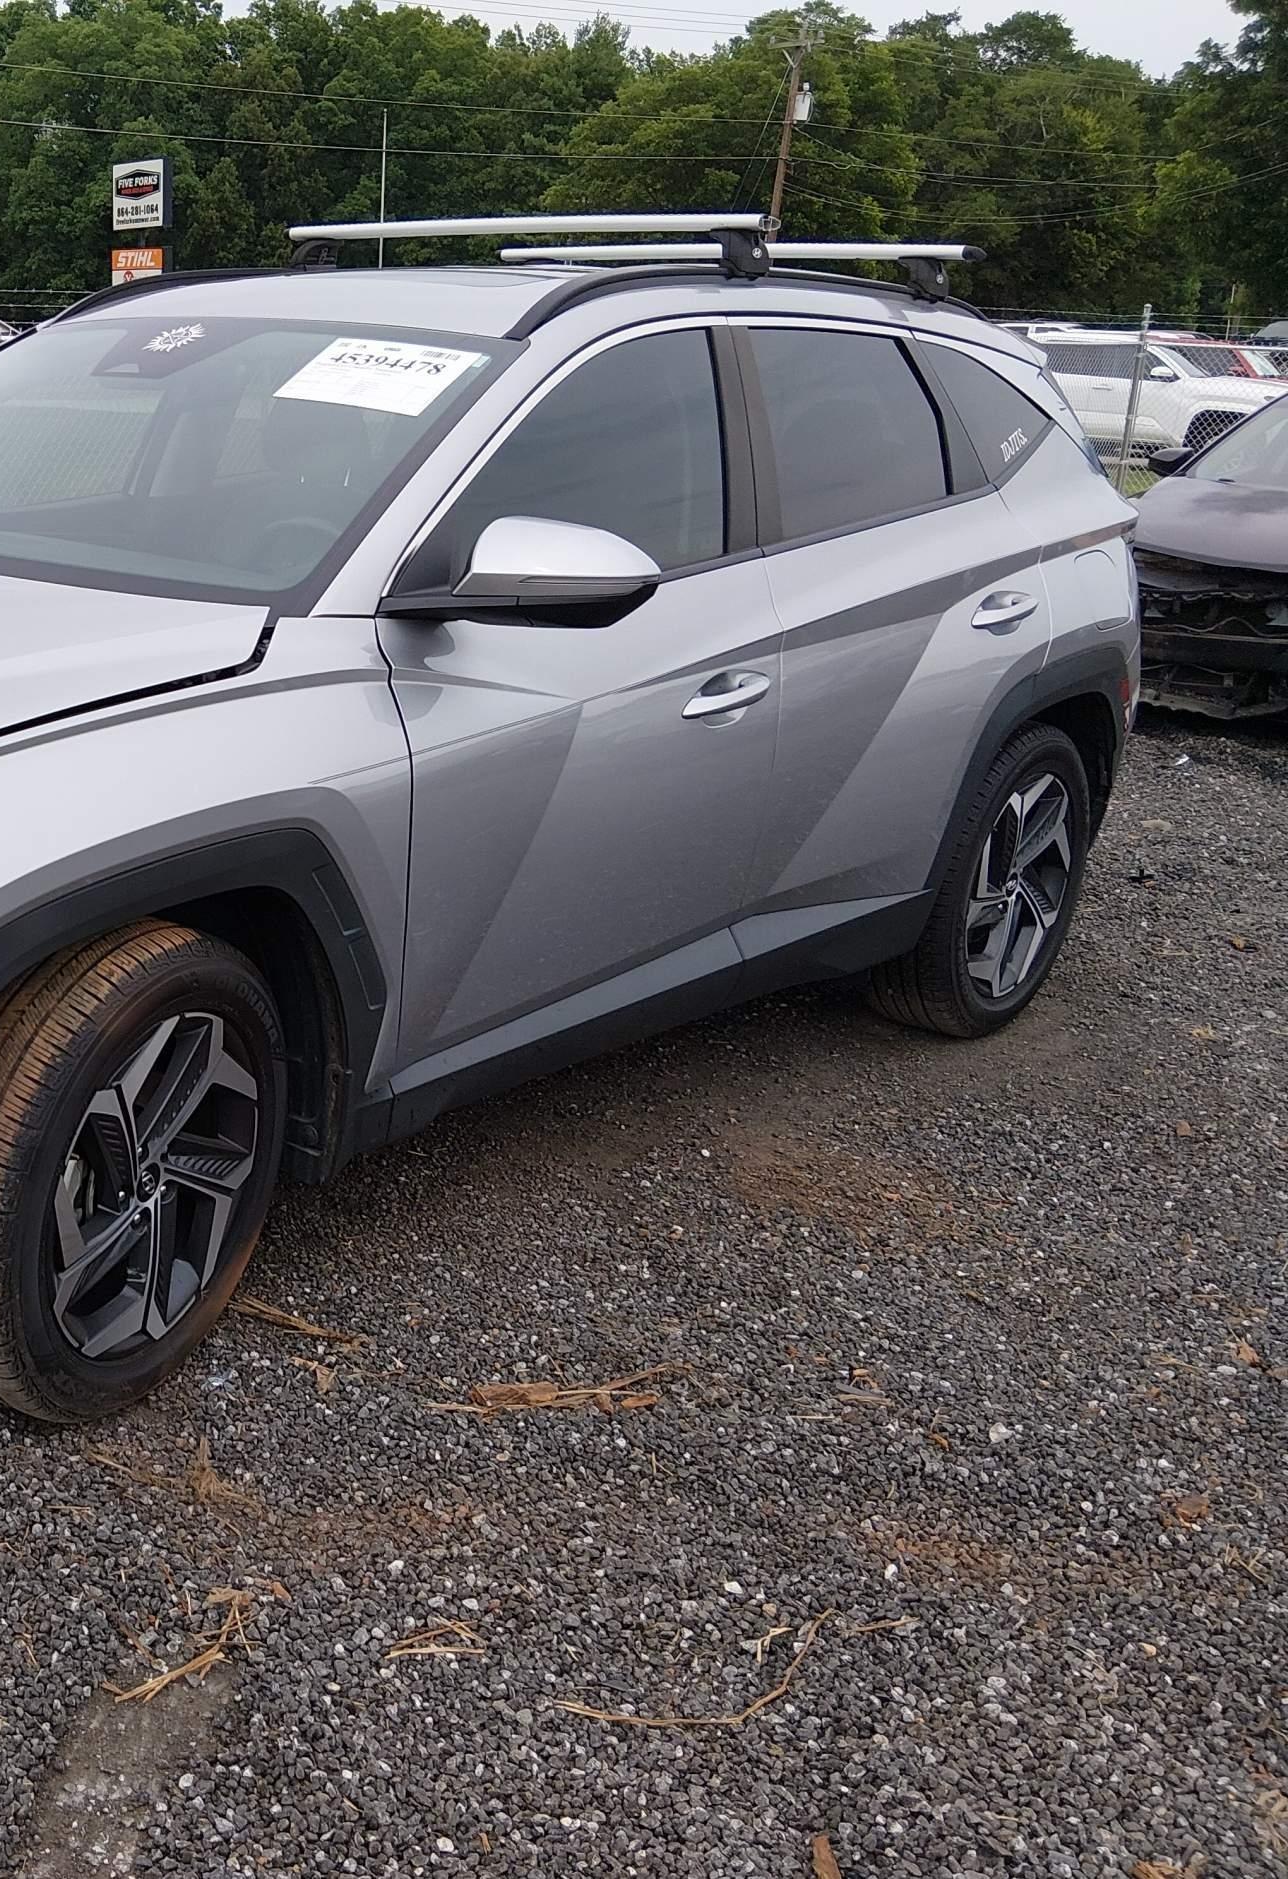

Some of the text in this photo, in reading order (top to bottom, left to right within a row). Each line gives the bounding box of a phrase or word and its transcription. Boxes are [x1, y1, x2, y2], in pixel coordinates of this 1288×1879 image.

[118, 175, 158, 189] FIVE FORKS
[117, 203, 159, 218] 864-281-1064
[117, 251, 155, 268] STIHL
[330, 352, 447, 375] 45394478
